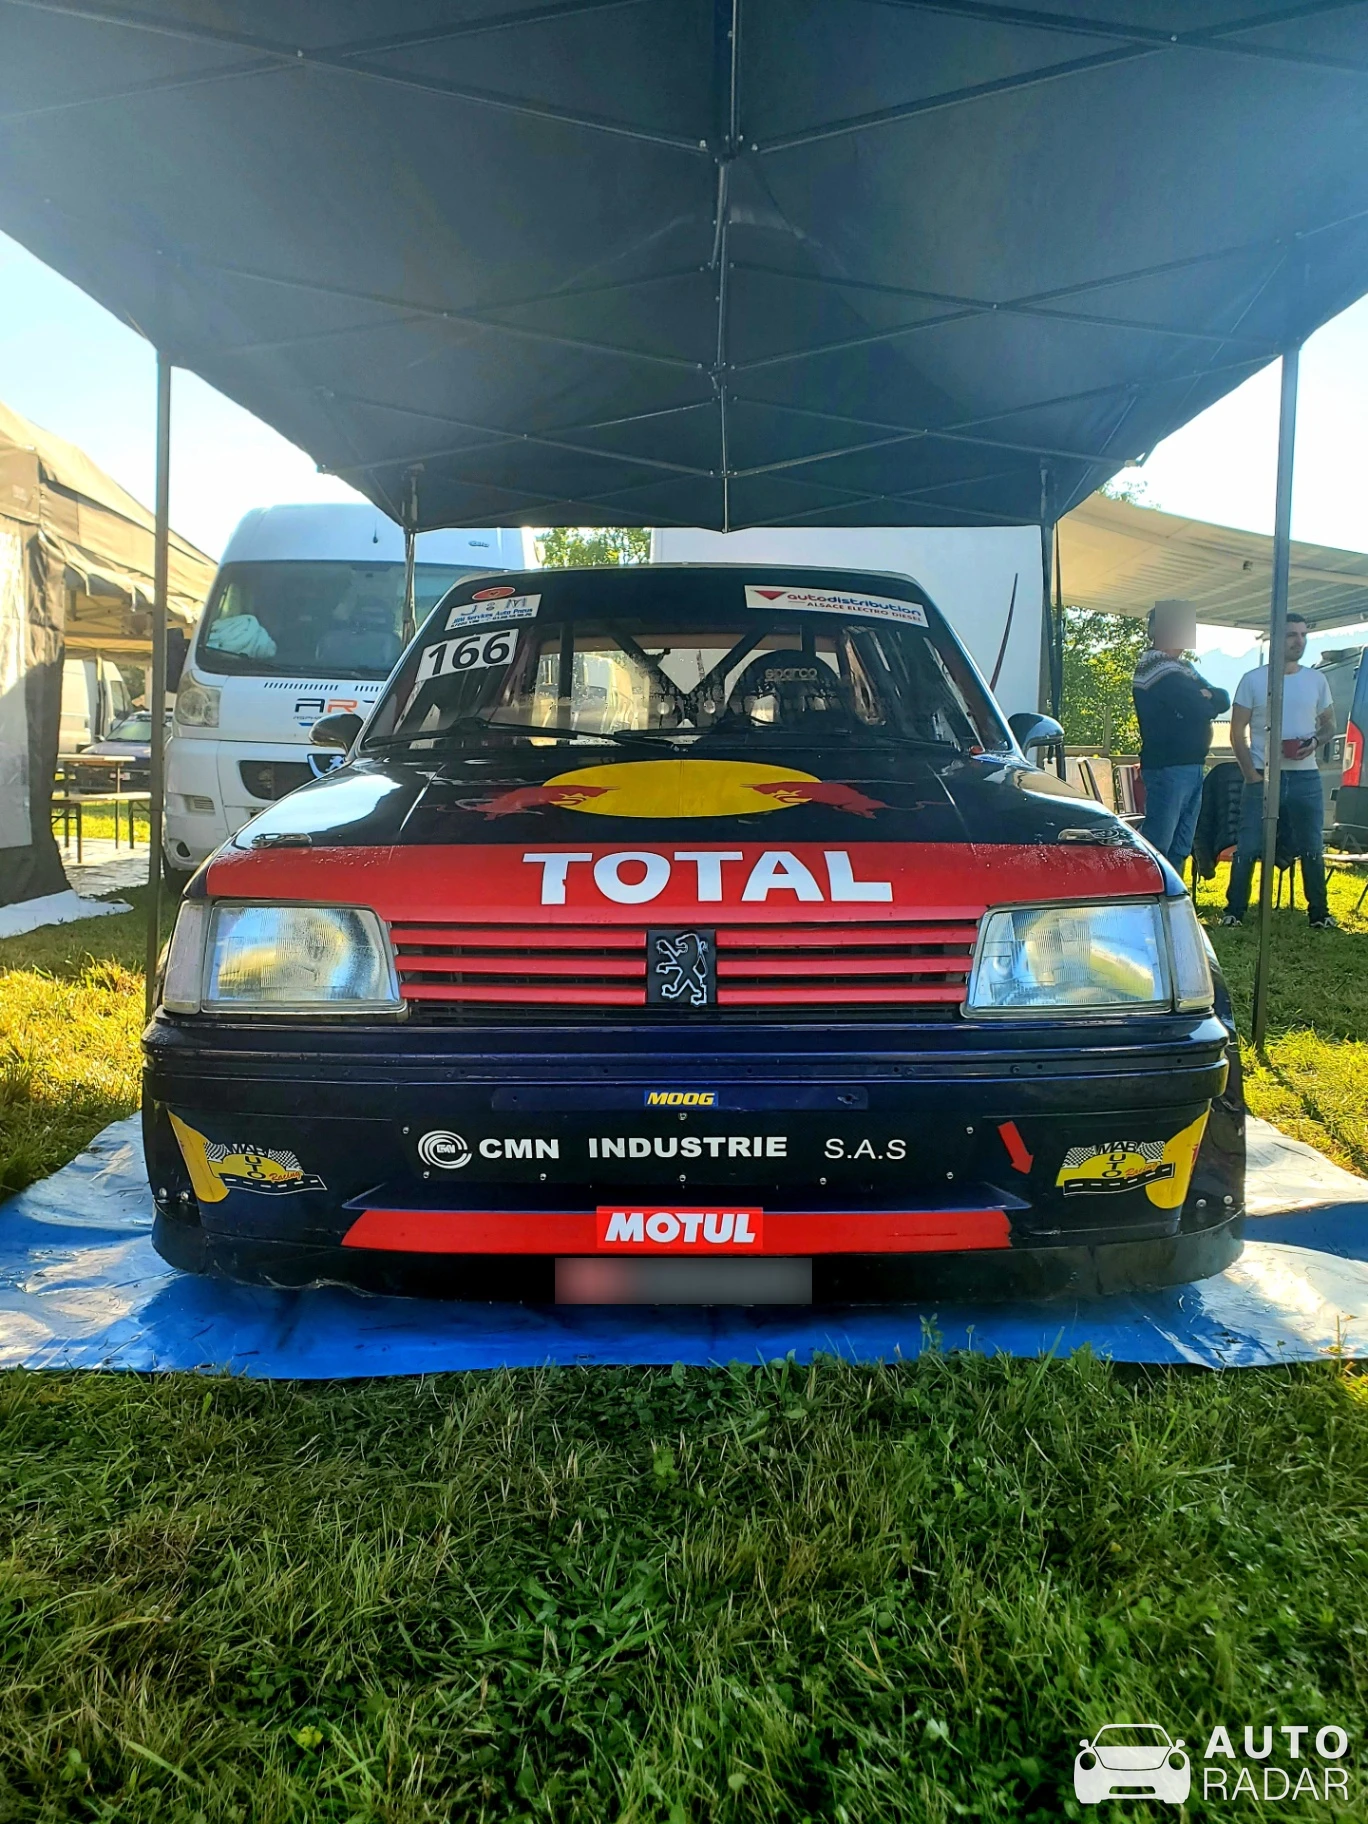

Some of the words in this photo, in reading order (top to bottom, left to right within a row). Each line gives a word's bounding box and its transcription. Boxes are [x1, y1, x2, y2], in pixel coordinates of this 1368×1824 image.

[787, 593, 922, 616] autodistribution
[807, 602, 844, 610] ALSACE
[847, 605, 889, 615] ELECTRO
[892, 612, 922, 622] DIESEL
[428, 632, 511, 676] 166
[765, 668, 818, 684] sparco
[522, 851, 893, 905] TOTAL
[646, 1093, 716, 1106] MOOG
[479, 1138, 560, 1159] CMN
[588, 1136, 788, 1158] INDUSTRIE
[824, 1138, 907, 1160] S.A.S
[269, 1170, 301, 1182] Racing
[1124, 1162, 1158, 1178] Racing
[604, 1212, 756, 1244] MOTUL
